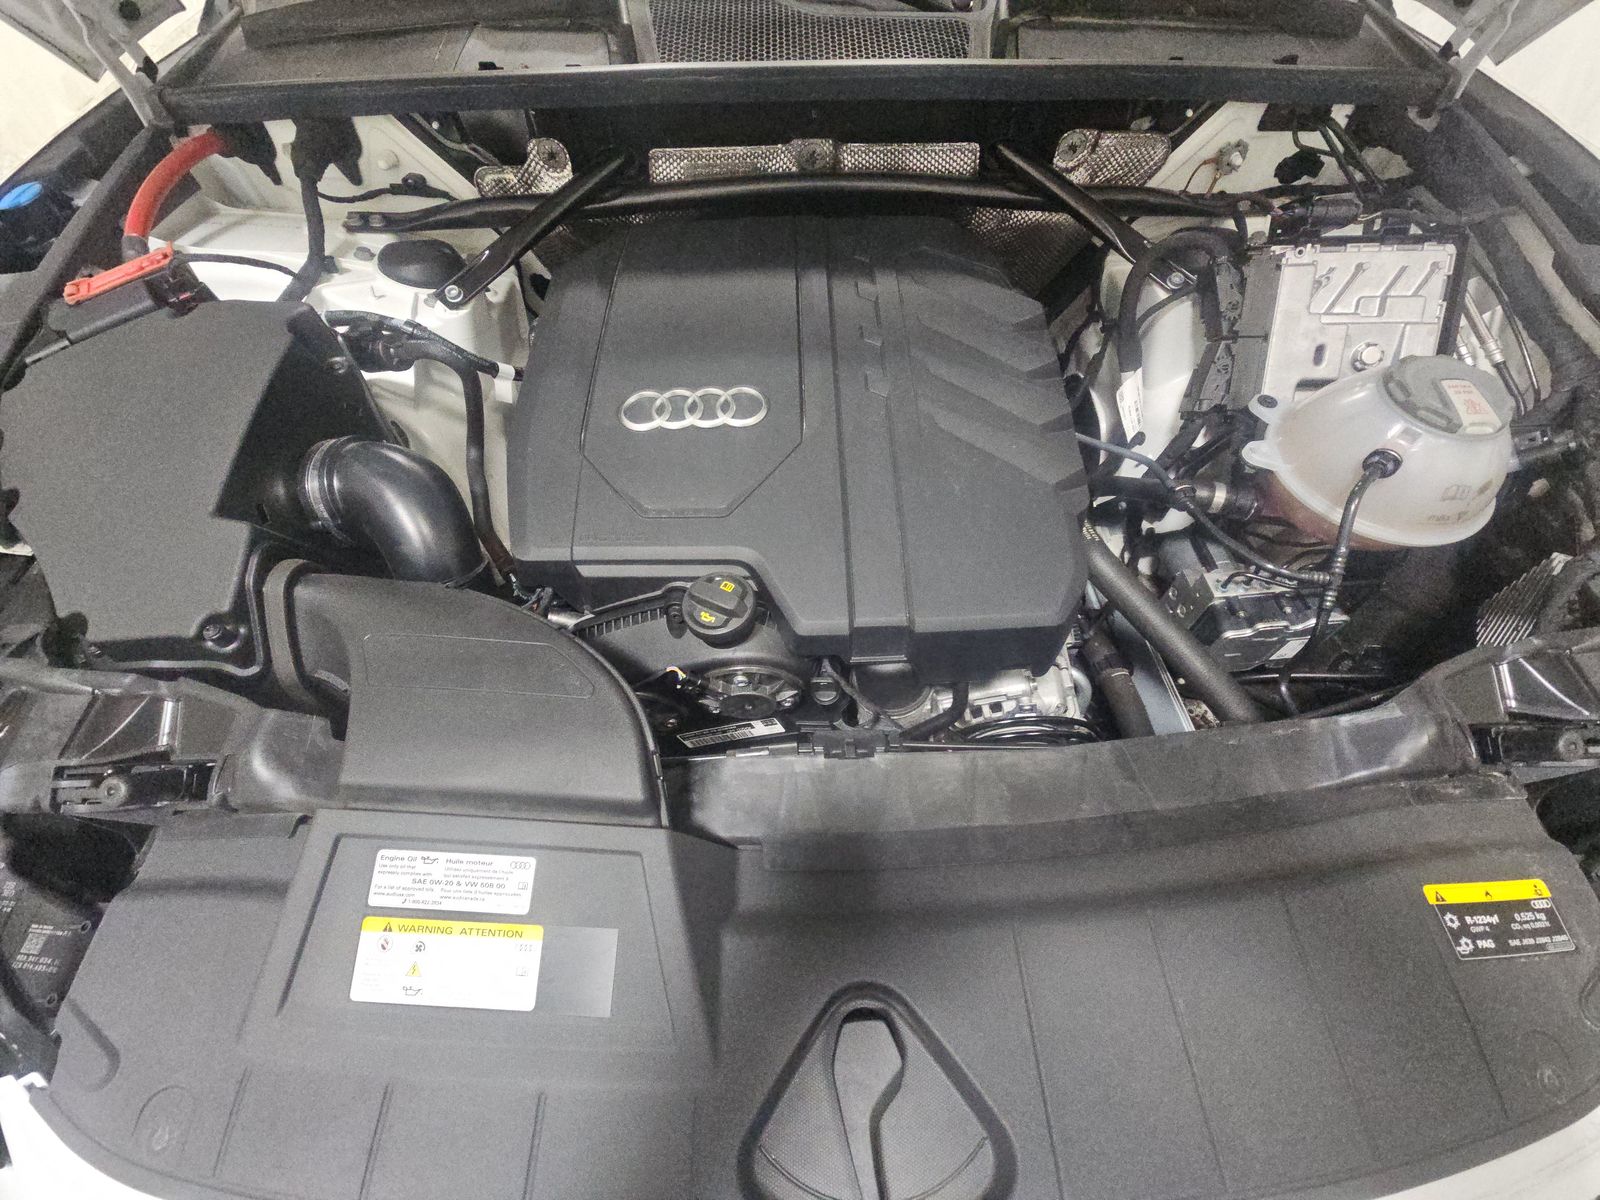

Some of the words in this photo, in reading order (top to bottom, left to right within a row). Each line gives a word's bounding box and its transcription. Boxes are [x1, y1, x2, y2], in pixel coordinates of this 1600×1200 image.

[1464, 914, 1500, 925] R-1234yf
[1536, 912, 1546, 920] kg
[398, 924, 453, 935] WARNING
[459, 928, 523, 938] ATTENTION
[1476, 939, 1496, 949] PAG
